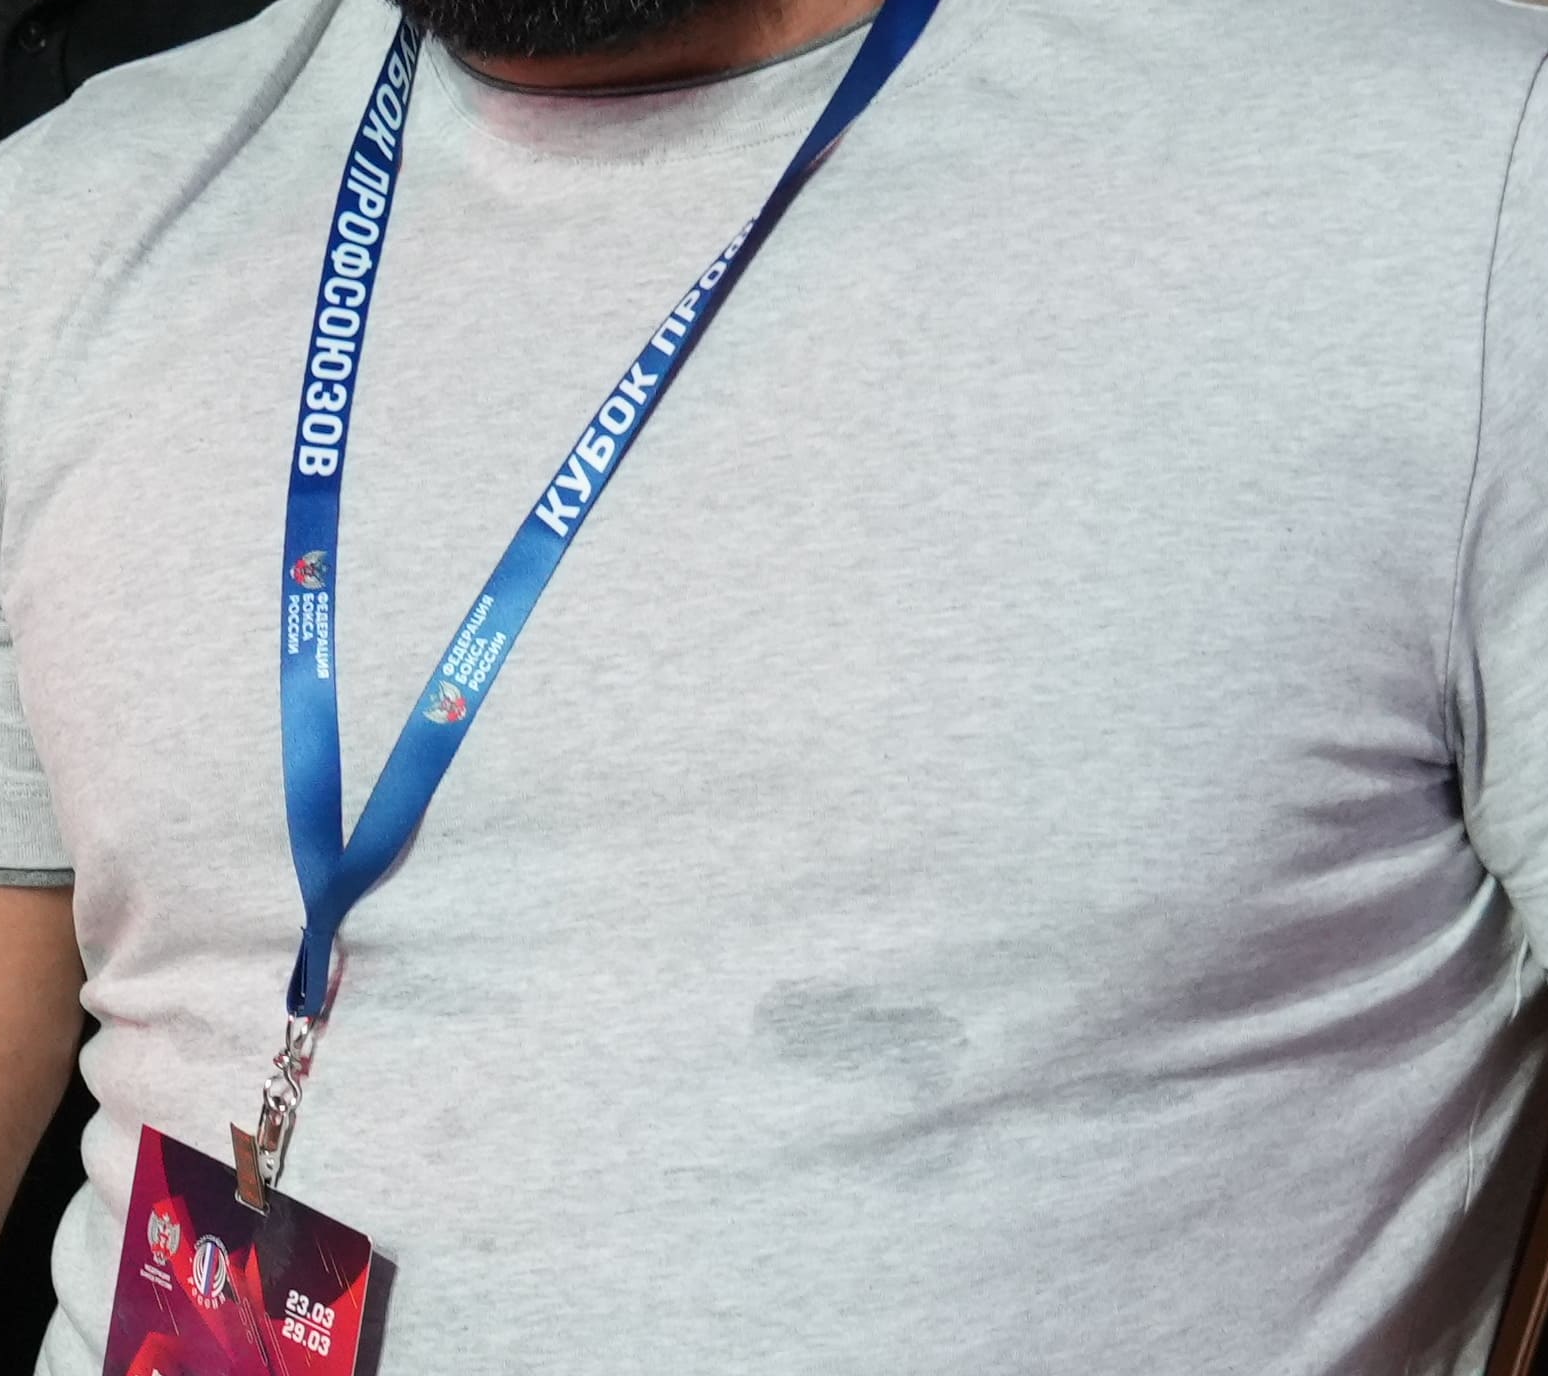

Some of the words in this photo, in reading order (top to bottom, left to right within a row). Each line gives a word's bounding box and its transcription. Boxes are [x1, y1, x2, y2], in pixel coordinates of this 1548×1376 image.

[298, 153, 390, 476] ПРОФСОЮЗОВ
[535, 361, 659, 538] КУБОК
[288, 594, 300, 655] РОССИИ
[302, 592, 315, 642] БОКСА
[315, 592, 330, 679] ФЕДЕРАЦИЯ
[442, 594, 495, 677] ФЕДЕРАЦИЯ
[454, 636, 489, 686] БОКСА
[468, 631, 507, 692] РОССИИ
[282, 1317, 330, 1355] 29.03
[286, 1290, 334, 1328] 23.03
